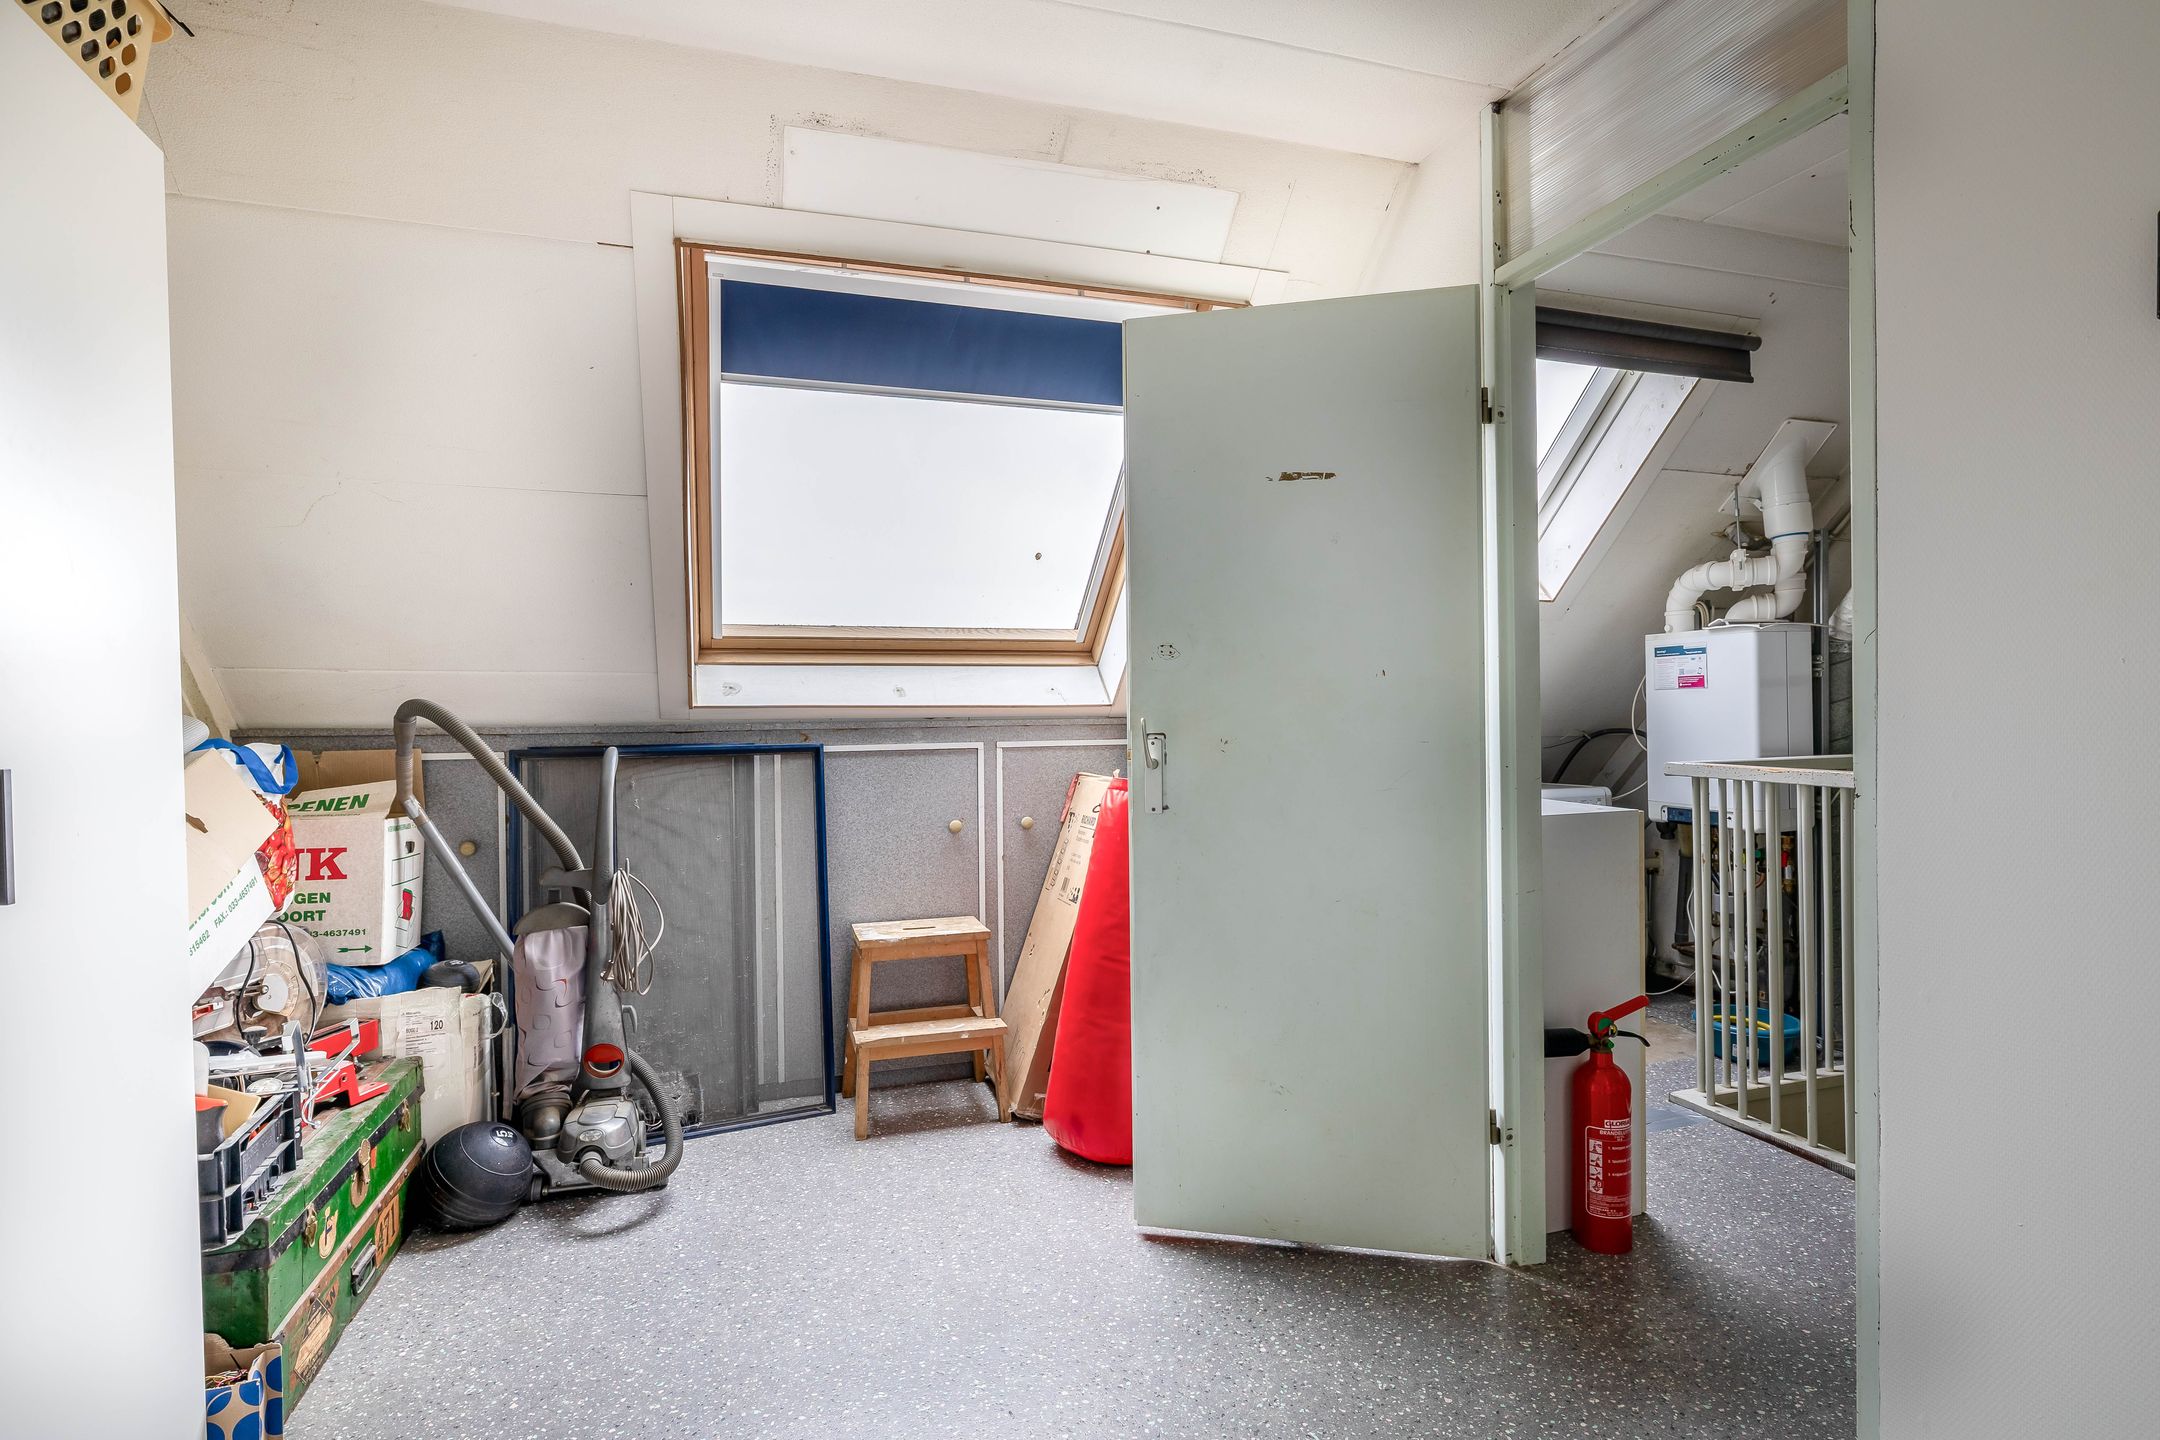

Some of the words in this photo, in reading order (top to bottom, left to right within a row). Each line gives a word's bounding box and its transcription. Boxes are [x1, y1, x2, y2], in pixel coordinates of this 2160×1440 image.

[294, 892, 331, 904] GEN
[277, 909, 326, 923] OORT
[430, 1019, 444, 1031] 120
[496, 1130, 508, 1138] 5
